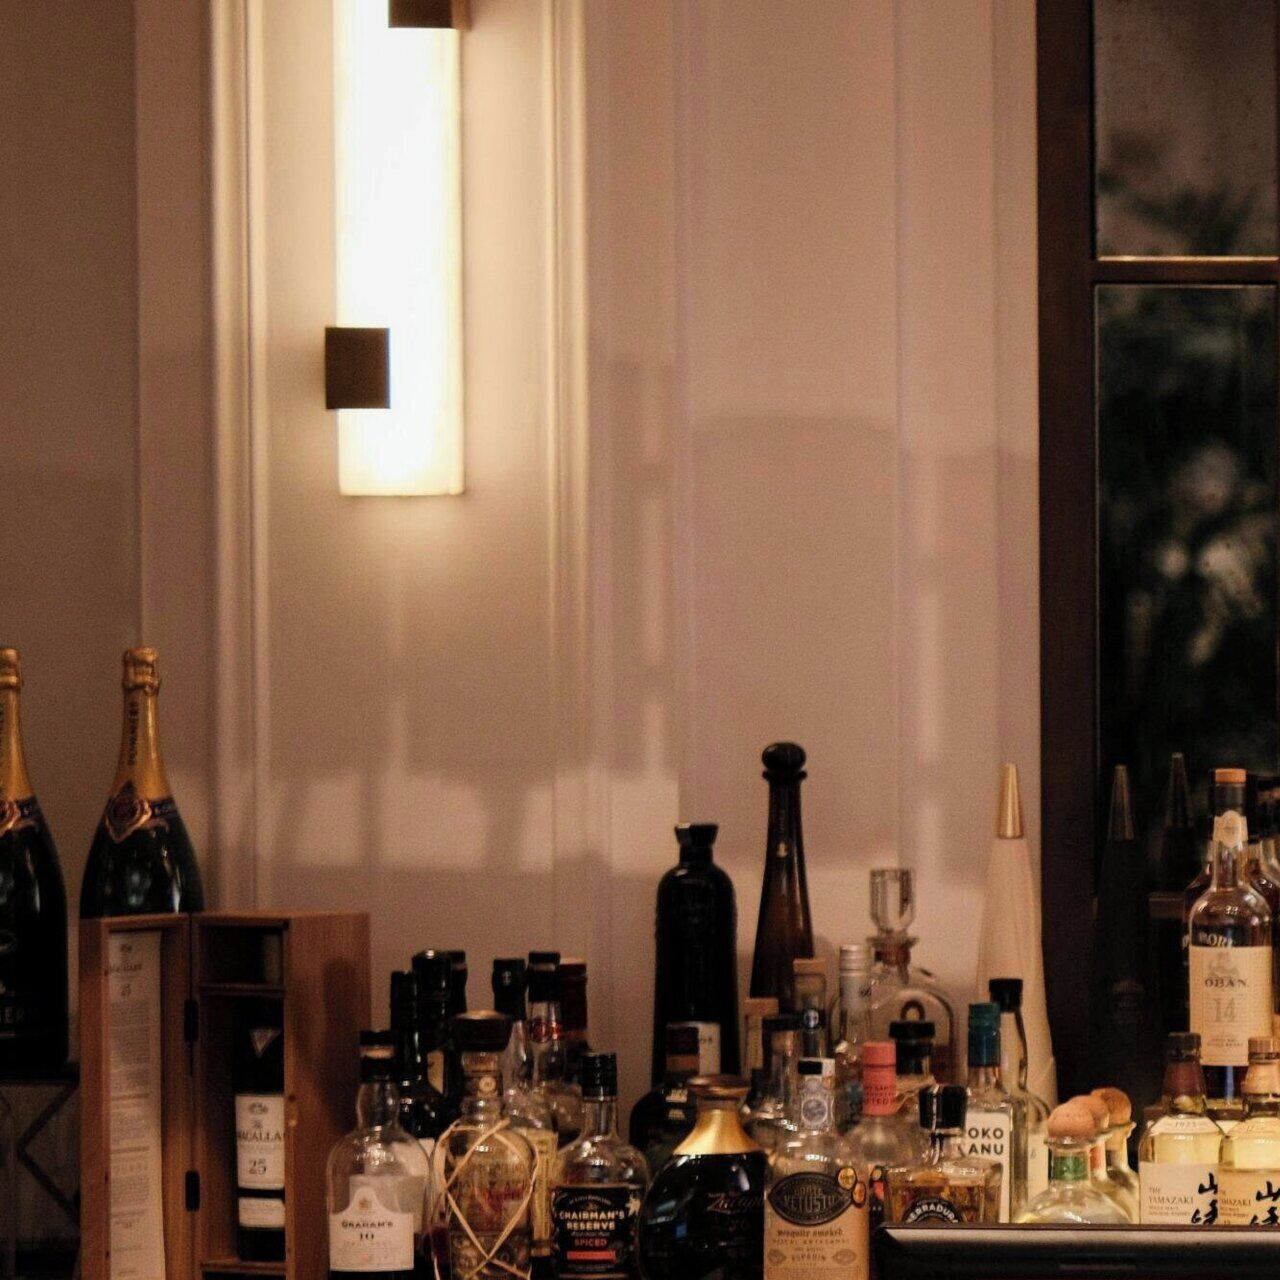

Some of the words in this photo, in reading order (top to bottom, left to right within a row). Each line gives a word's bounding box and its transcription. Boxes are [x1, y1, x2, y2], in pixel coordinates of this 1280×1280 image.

[1204, 977, 1248, 988] OBAN
[1174, 1120, 1196, 1128] 1923
[968, 1127, 1004, 1140] OKO
[248, 1158, 267, 1176] 25
[1148, 1196, 1194, 1205] YAMAZAKI
[558, 1209, 625, 1221] CHAIRMAN'S
[566, 1221, 616, 1231] RESERVE
[573, 1238, 608, 1247] SPICED
